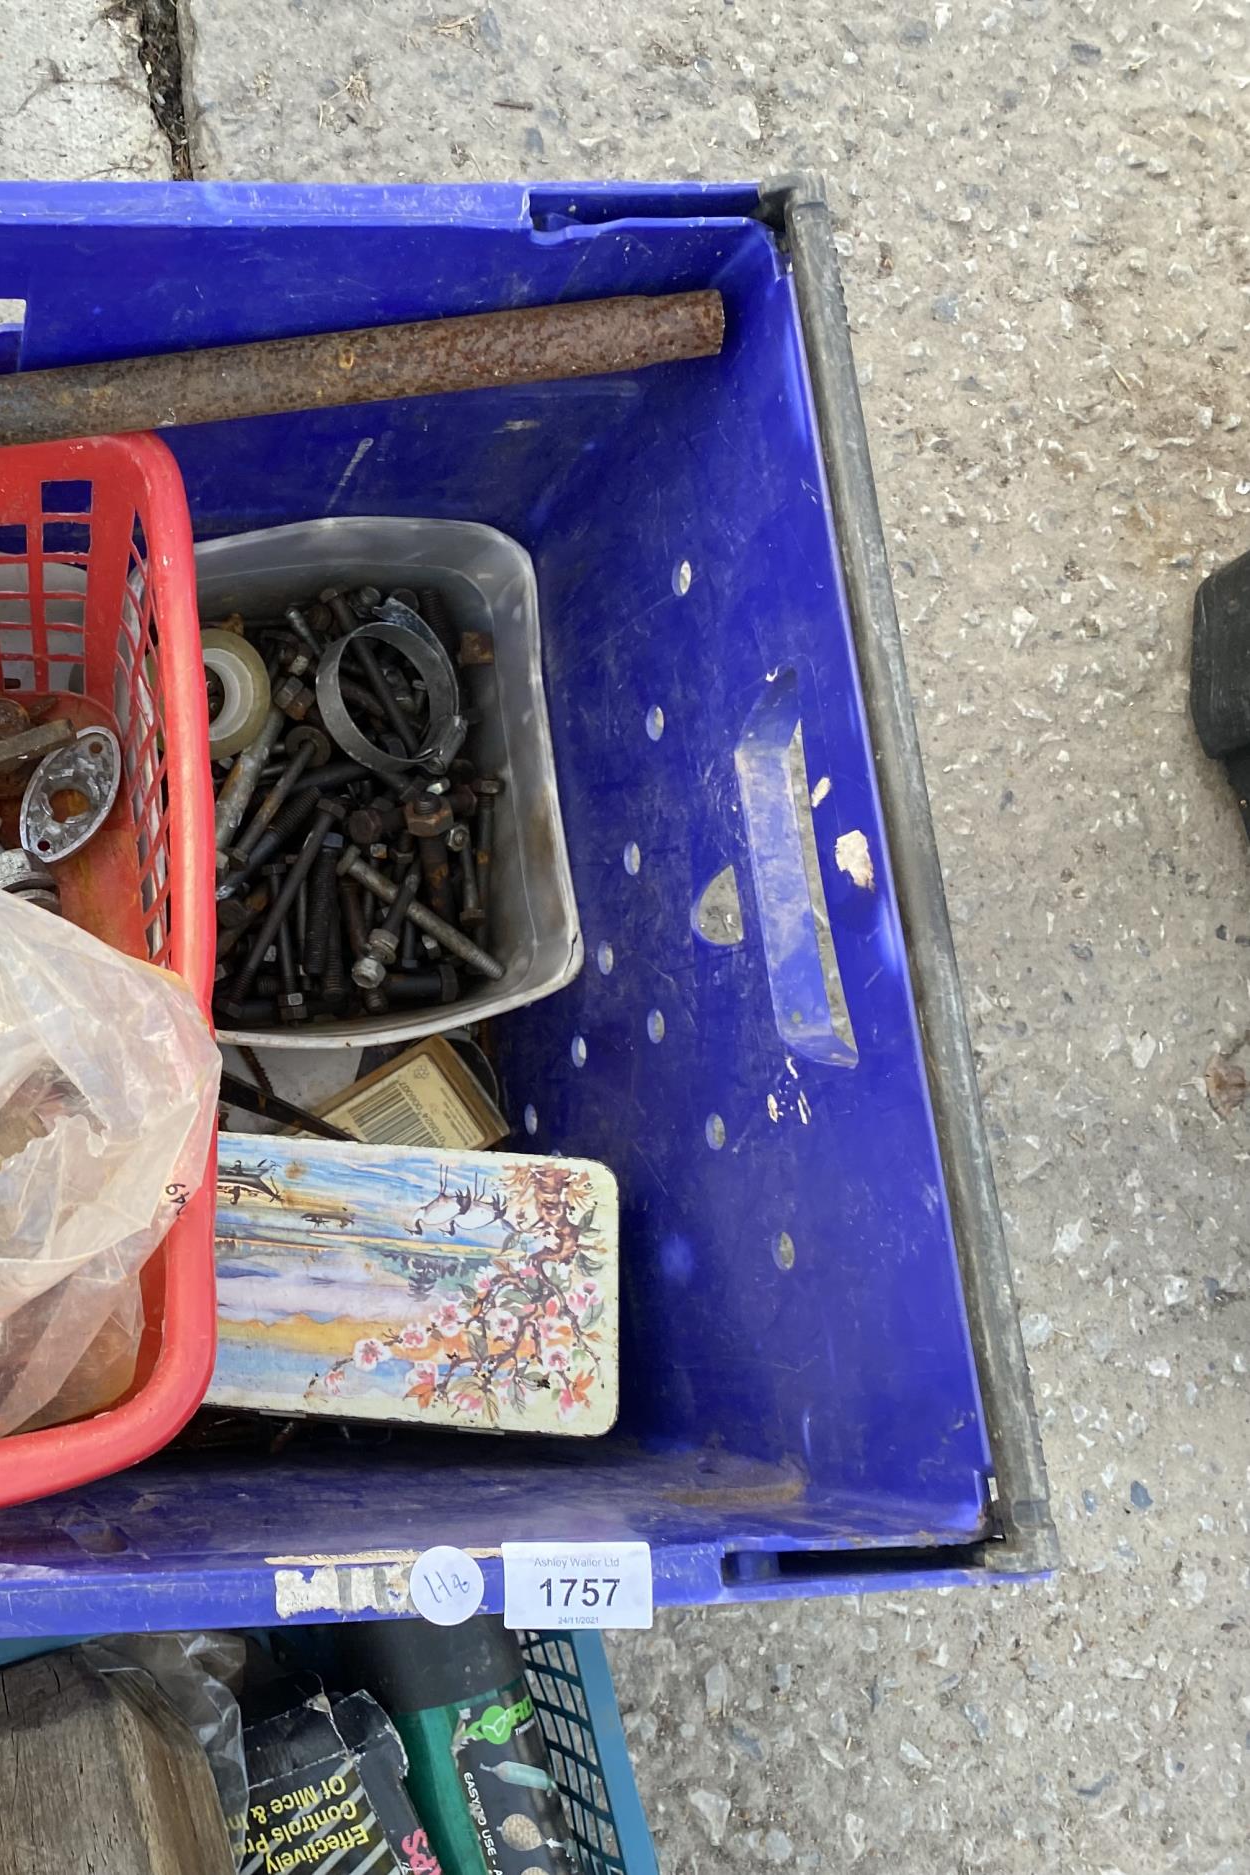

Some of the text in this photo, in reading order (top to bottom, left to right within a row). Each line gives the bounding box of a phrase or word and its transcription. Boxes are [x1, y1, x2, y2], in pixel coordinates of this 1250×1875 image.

[604, 1557, 620, 1568] Ltd
[539, 1578, 621, 1607] 1757
[557, 1616, 600, 1625] 24/11/2021
[270, 1786, 319, 1814] Mice
[321, 1775, 347, 1799] Of
[250, 1805, 267, 1824] &
[271, 1800, 358, 1843] Controls
[463, 1771, 482, 1805] EASY
[481, 1829, 498, 1857] USE
[265, 1820, 370, 1875] Effectively
